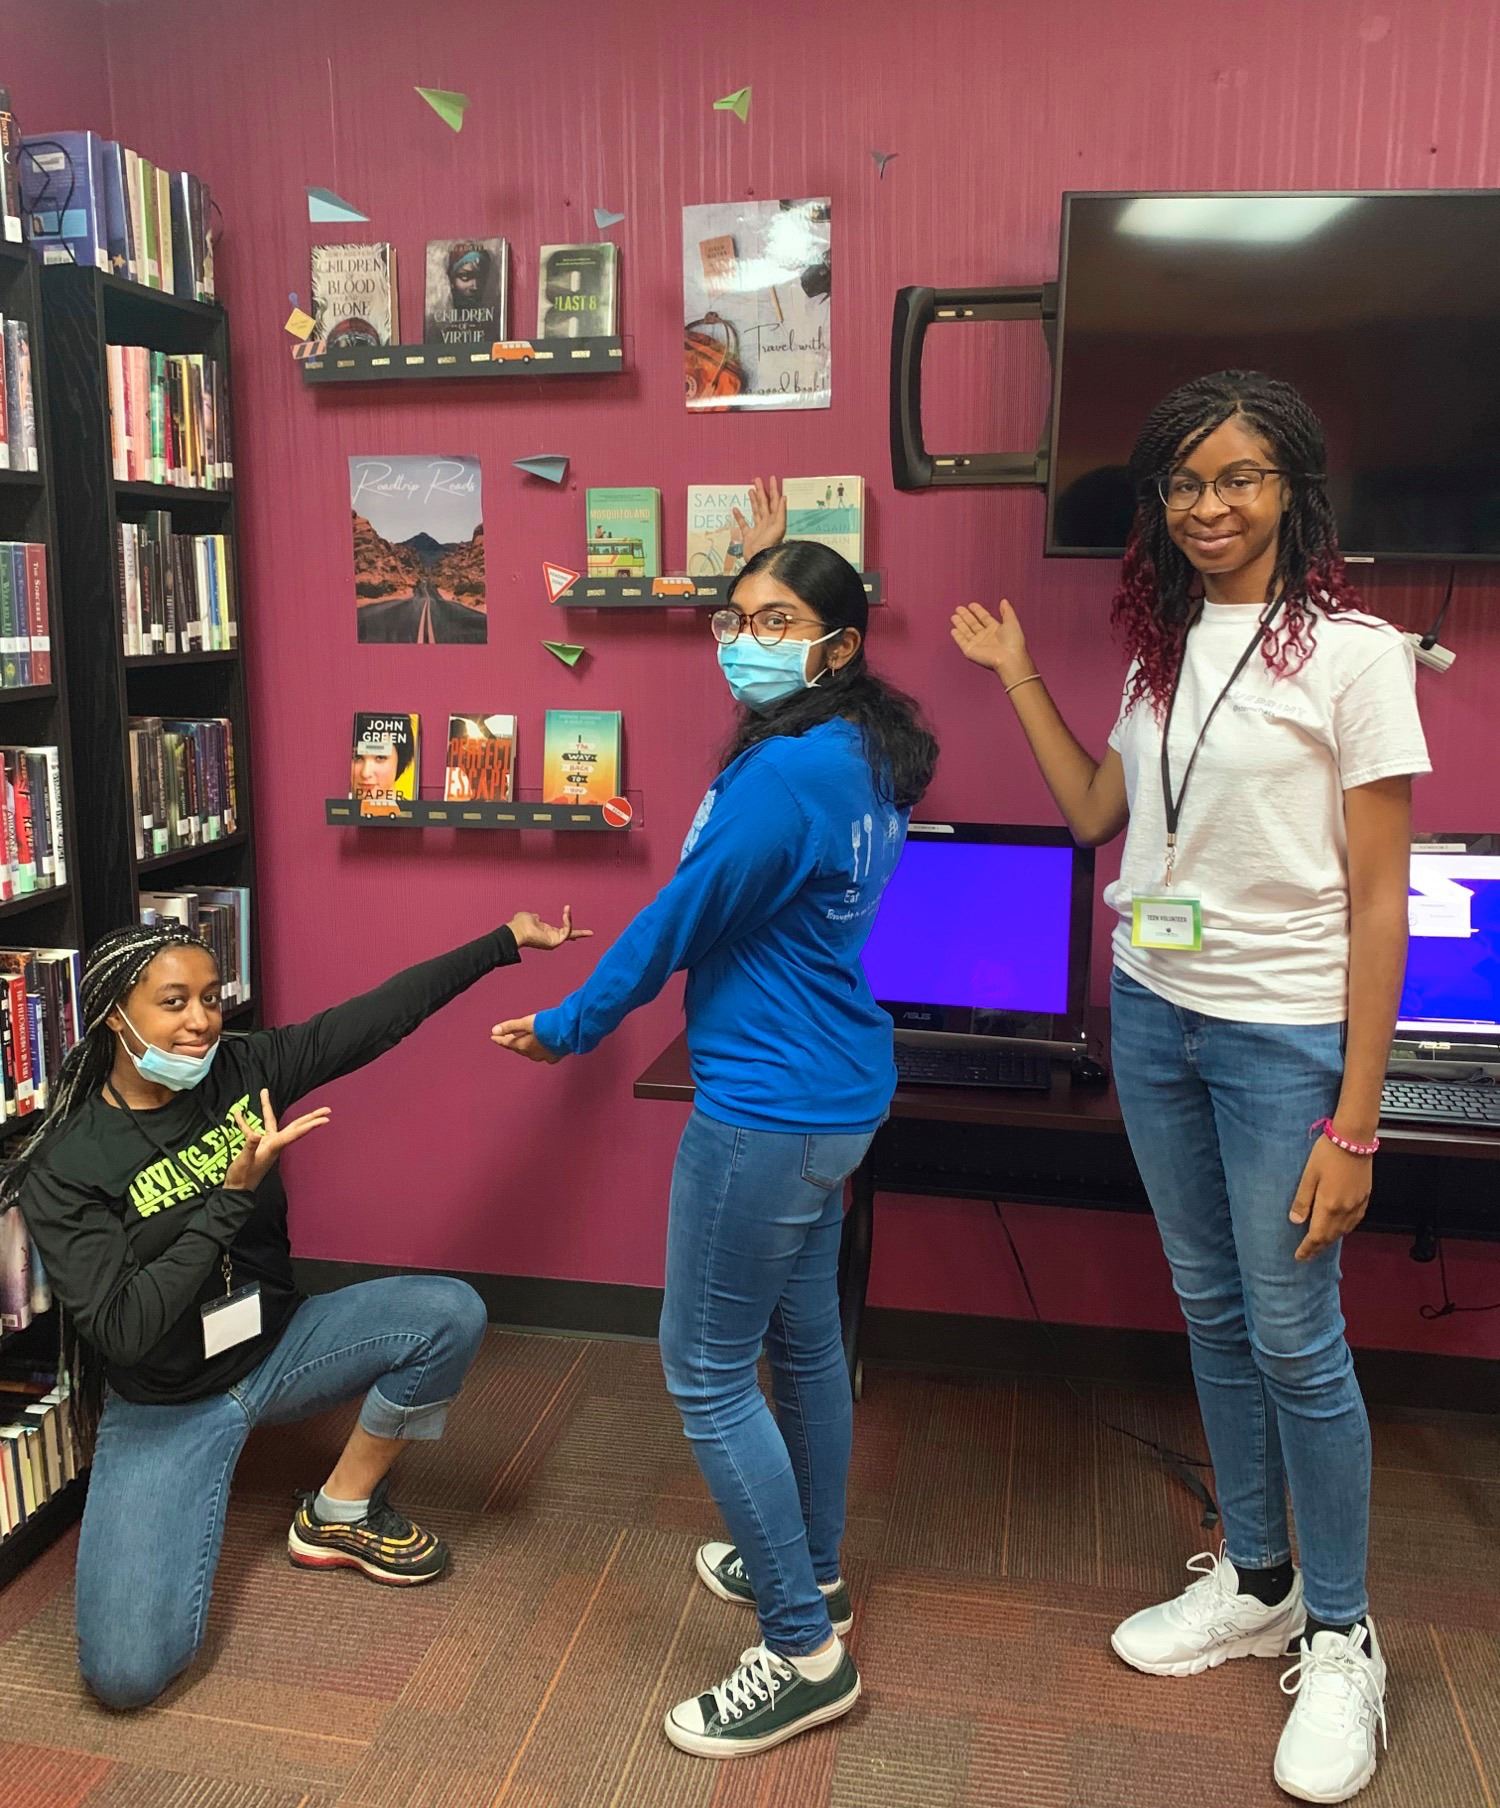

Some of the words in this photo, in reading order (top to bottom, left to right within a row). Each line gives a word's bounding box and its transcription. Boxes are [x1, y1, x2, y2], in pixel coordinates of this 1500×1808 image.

[319, 258, 382, 273] CHILDREN
[327, 279, 376, 295] BLOOD
[333, 301, 371, 316] BONE
[558, 295, 585, 312] LAST
[588, 295, 598, 311] 8
[433, 306, 495, 323] CHILDREN
[441, 330, 486, 344] VIRTUE
[743, 323, 794, 362] Travel
[799, 325, 827, 351] with
[351, 461, 420, 504] Roadtrip
[423, 460, 475, 504] Reads
[694, 514, 754, 529] DESS
[367, 720, 404, 731] JOHN
[362, 731, 407, 744] GREEN
[449, 738, 513, 769] PERFECT
[567, 753, 591, 761] WAY
[447, 768, 511, 800] ESCAPE
[571, 775, 581, 783] TO
[355, 788, 405, 801] PAPER
[844, 889, 860, 903] Eat
[902, 1011, 932, 1021] ASUS
